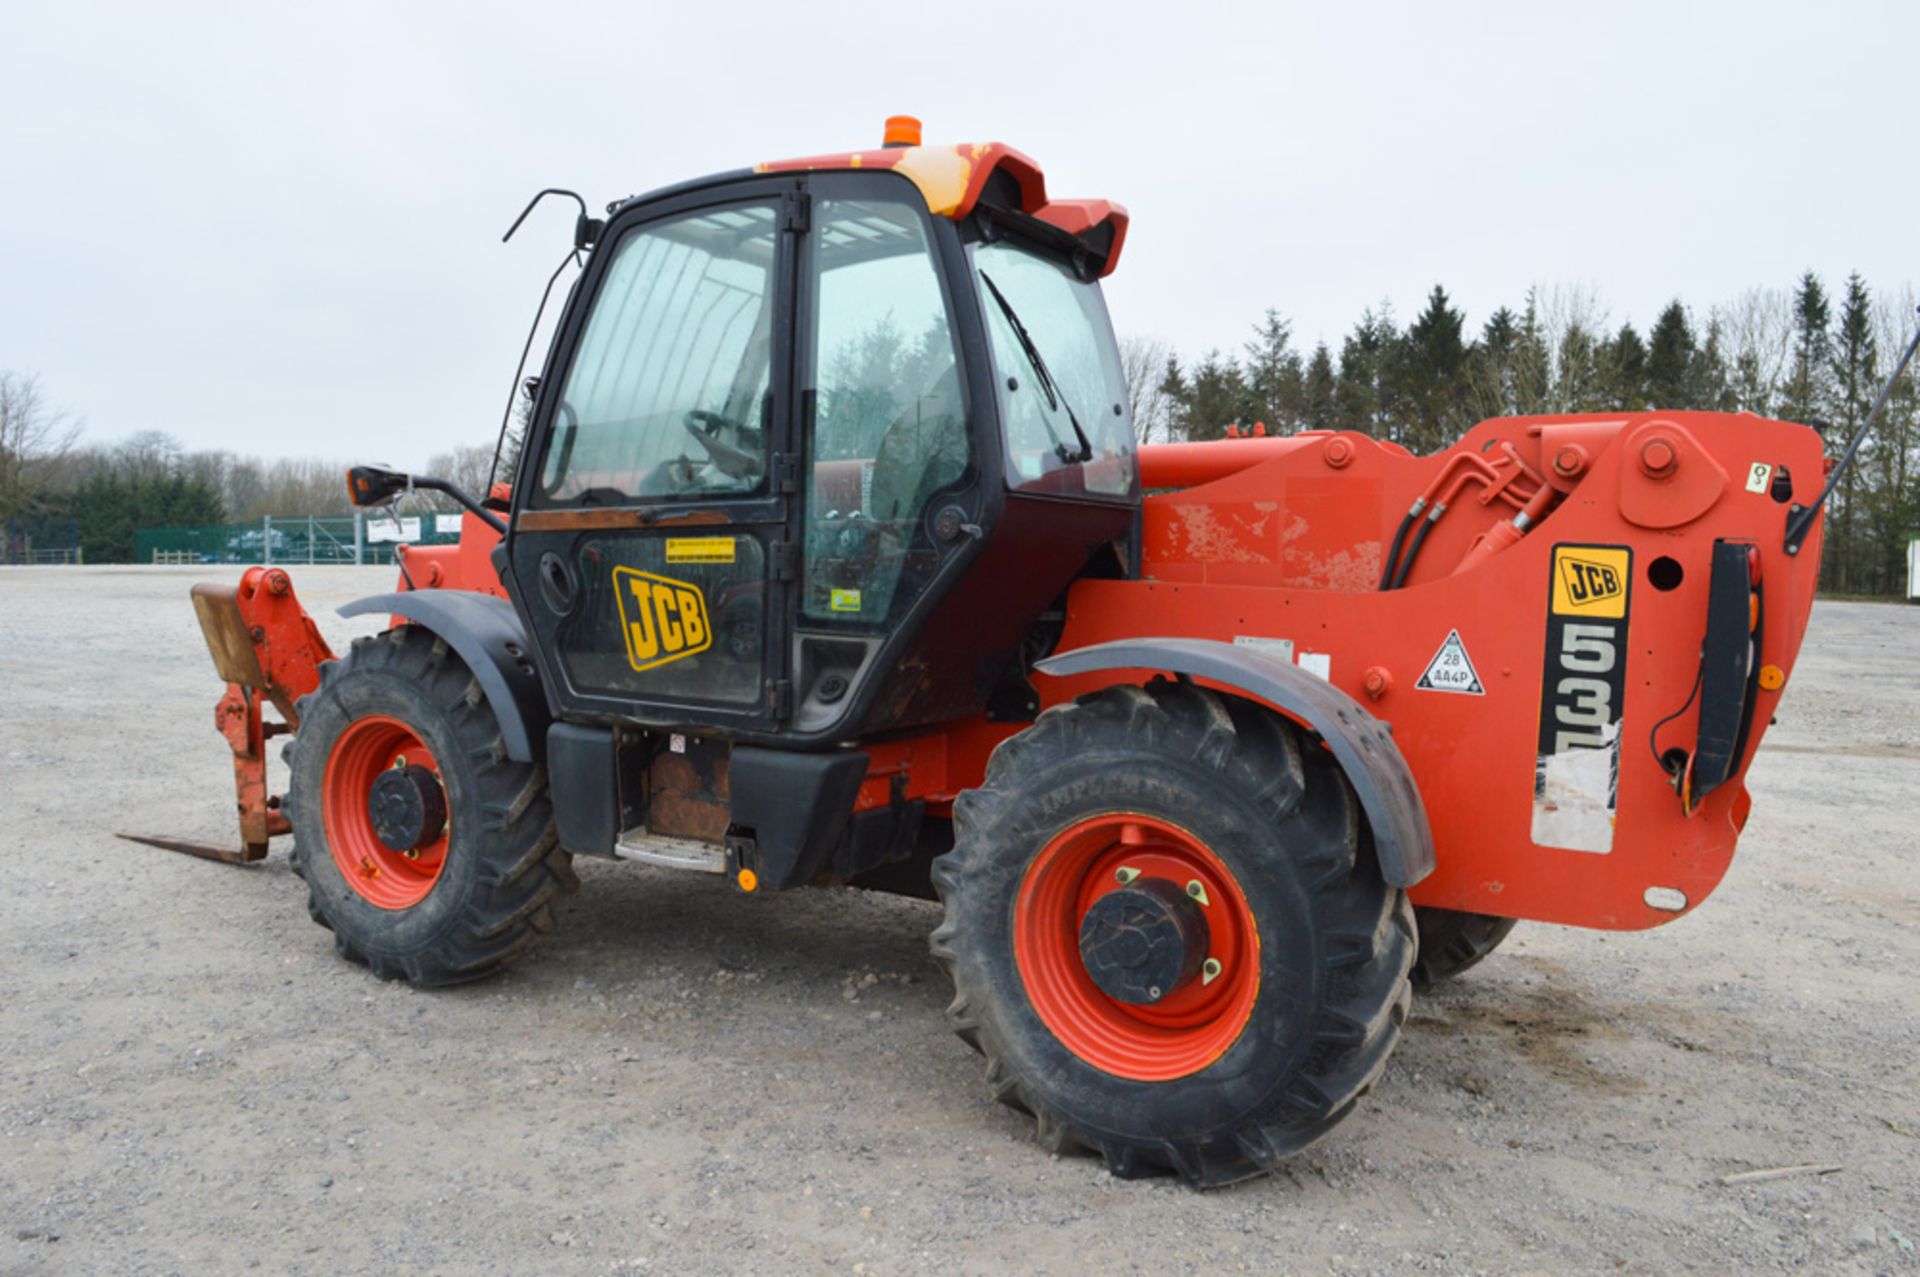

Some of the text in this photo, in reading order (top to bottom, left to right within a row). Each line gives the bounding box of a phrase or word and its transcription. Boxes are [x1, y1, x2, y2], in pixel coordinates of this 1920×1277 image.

[1571, 562, 1617, 601] JCB
[629, 577, 705, 660] JCB
[1443, 654, 1460, 666] 28
[1434, 670, 1468, 683] AA4P
